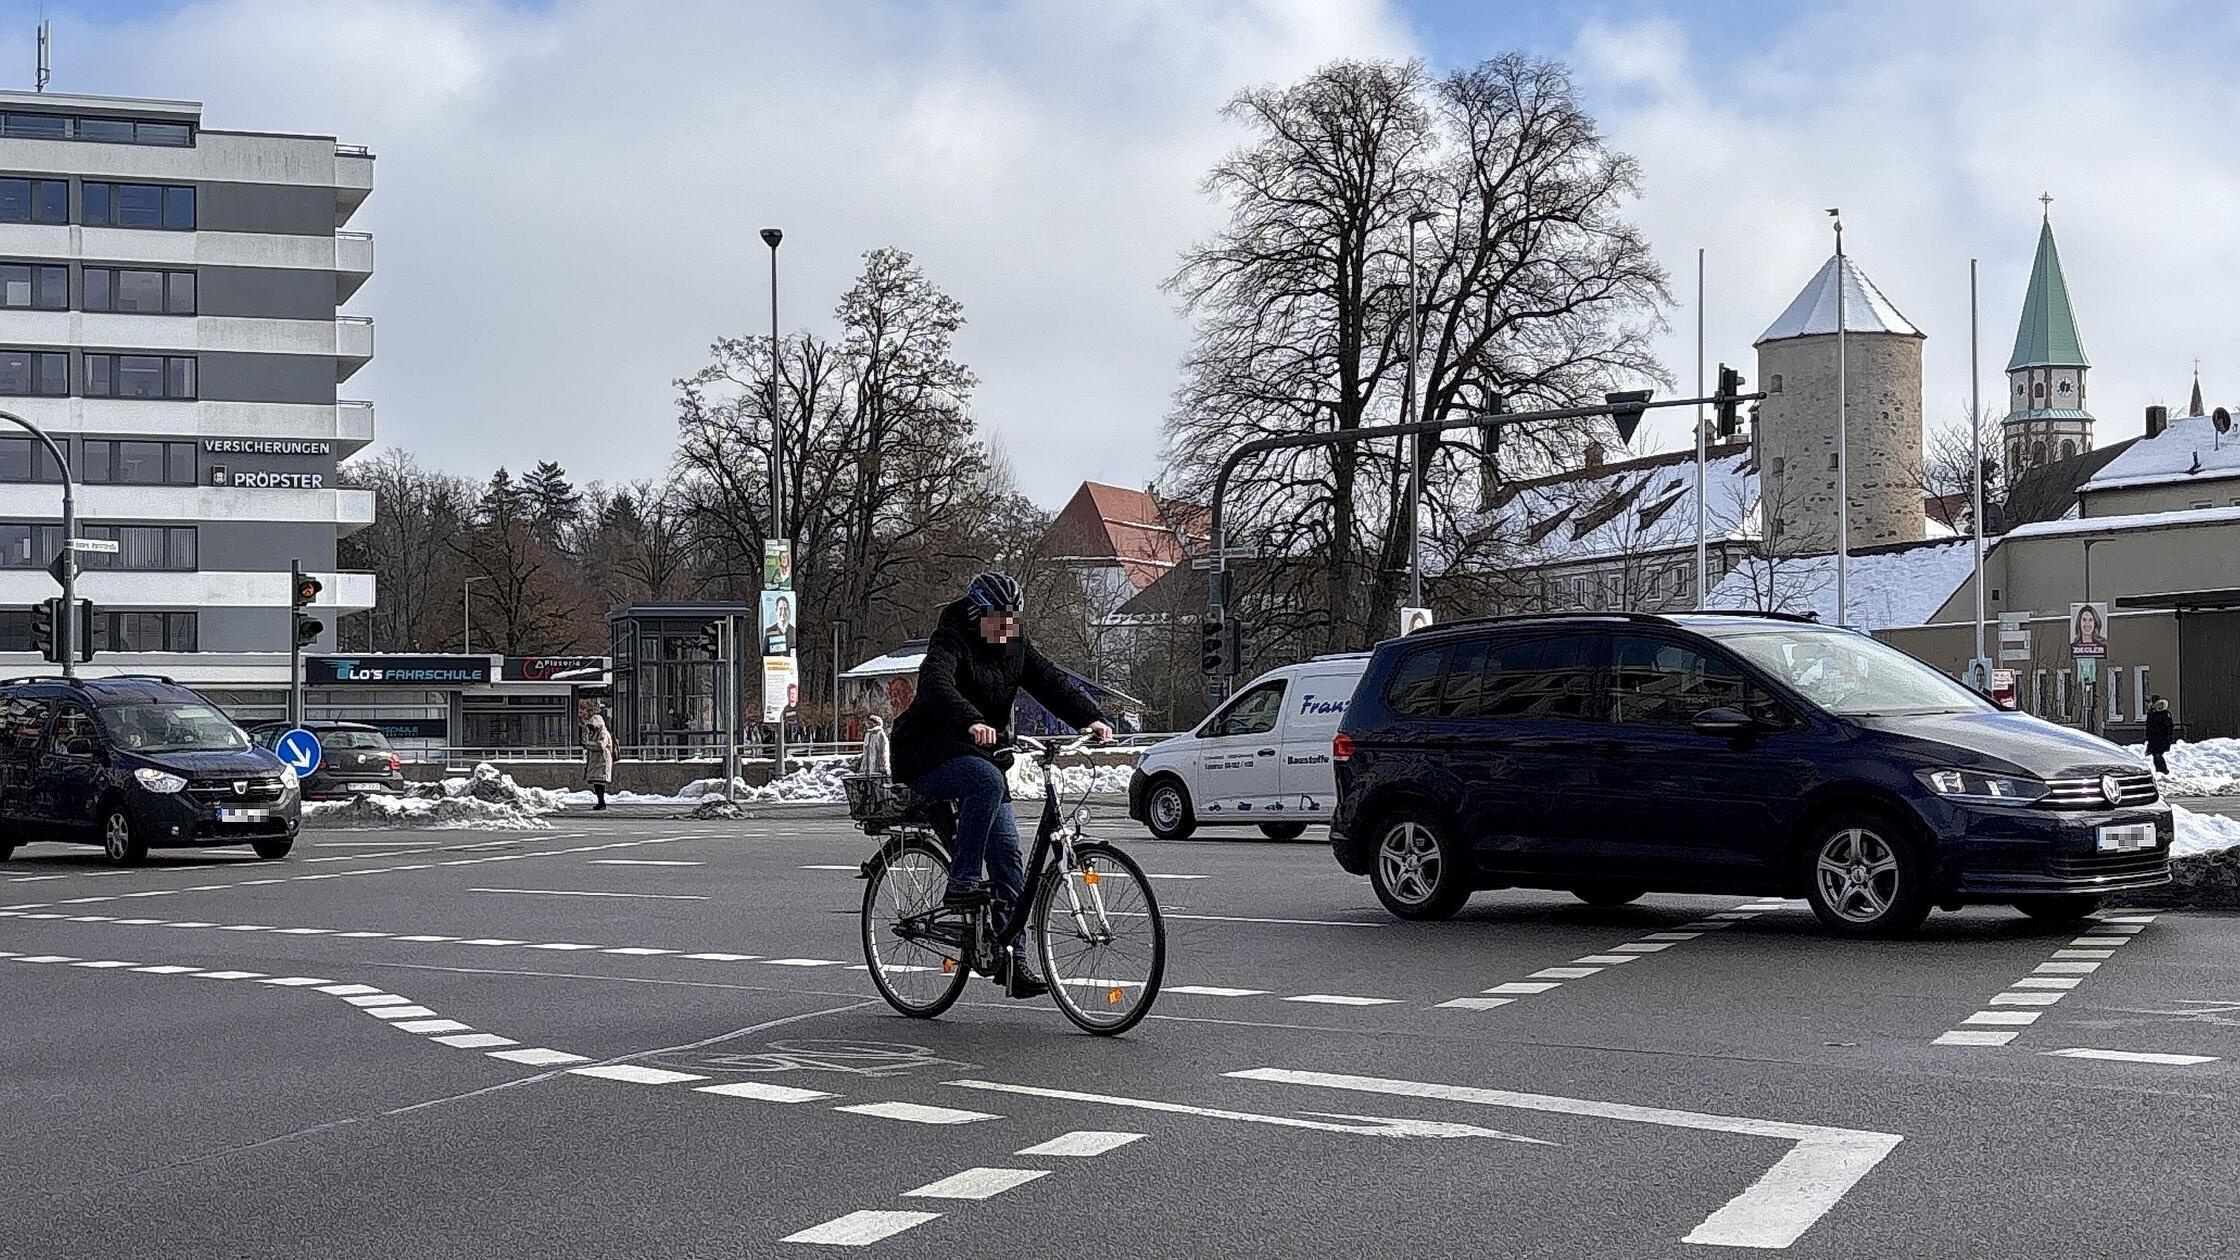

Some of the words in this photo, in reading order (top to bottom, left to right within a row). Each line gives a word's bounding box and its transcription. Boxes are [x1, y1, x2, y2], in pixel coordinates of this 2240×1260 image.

[205, 440, 330, 454] VERSICHERUNGEN
[234, 470, 323, 488] PRÖPSTER
[385, 669, 482, 680] FAHRSCHULE
